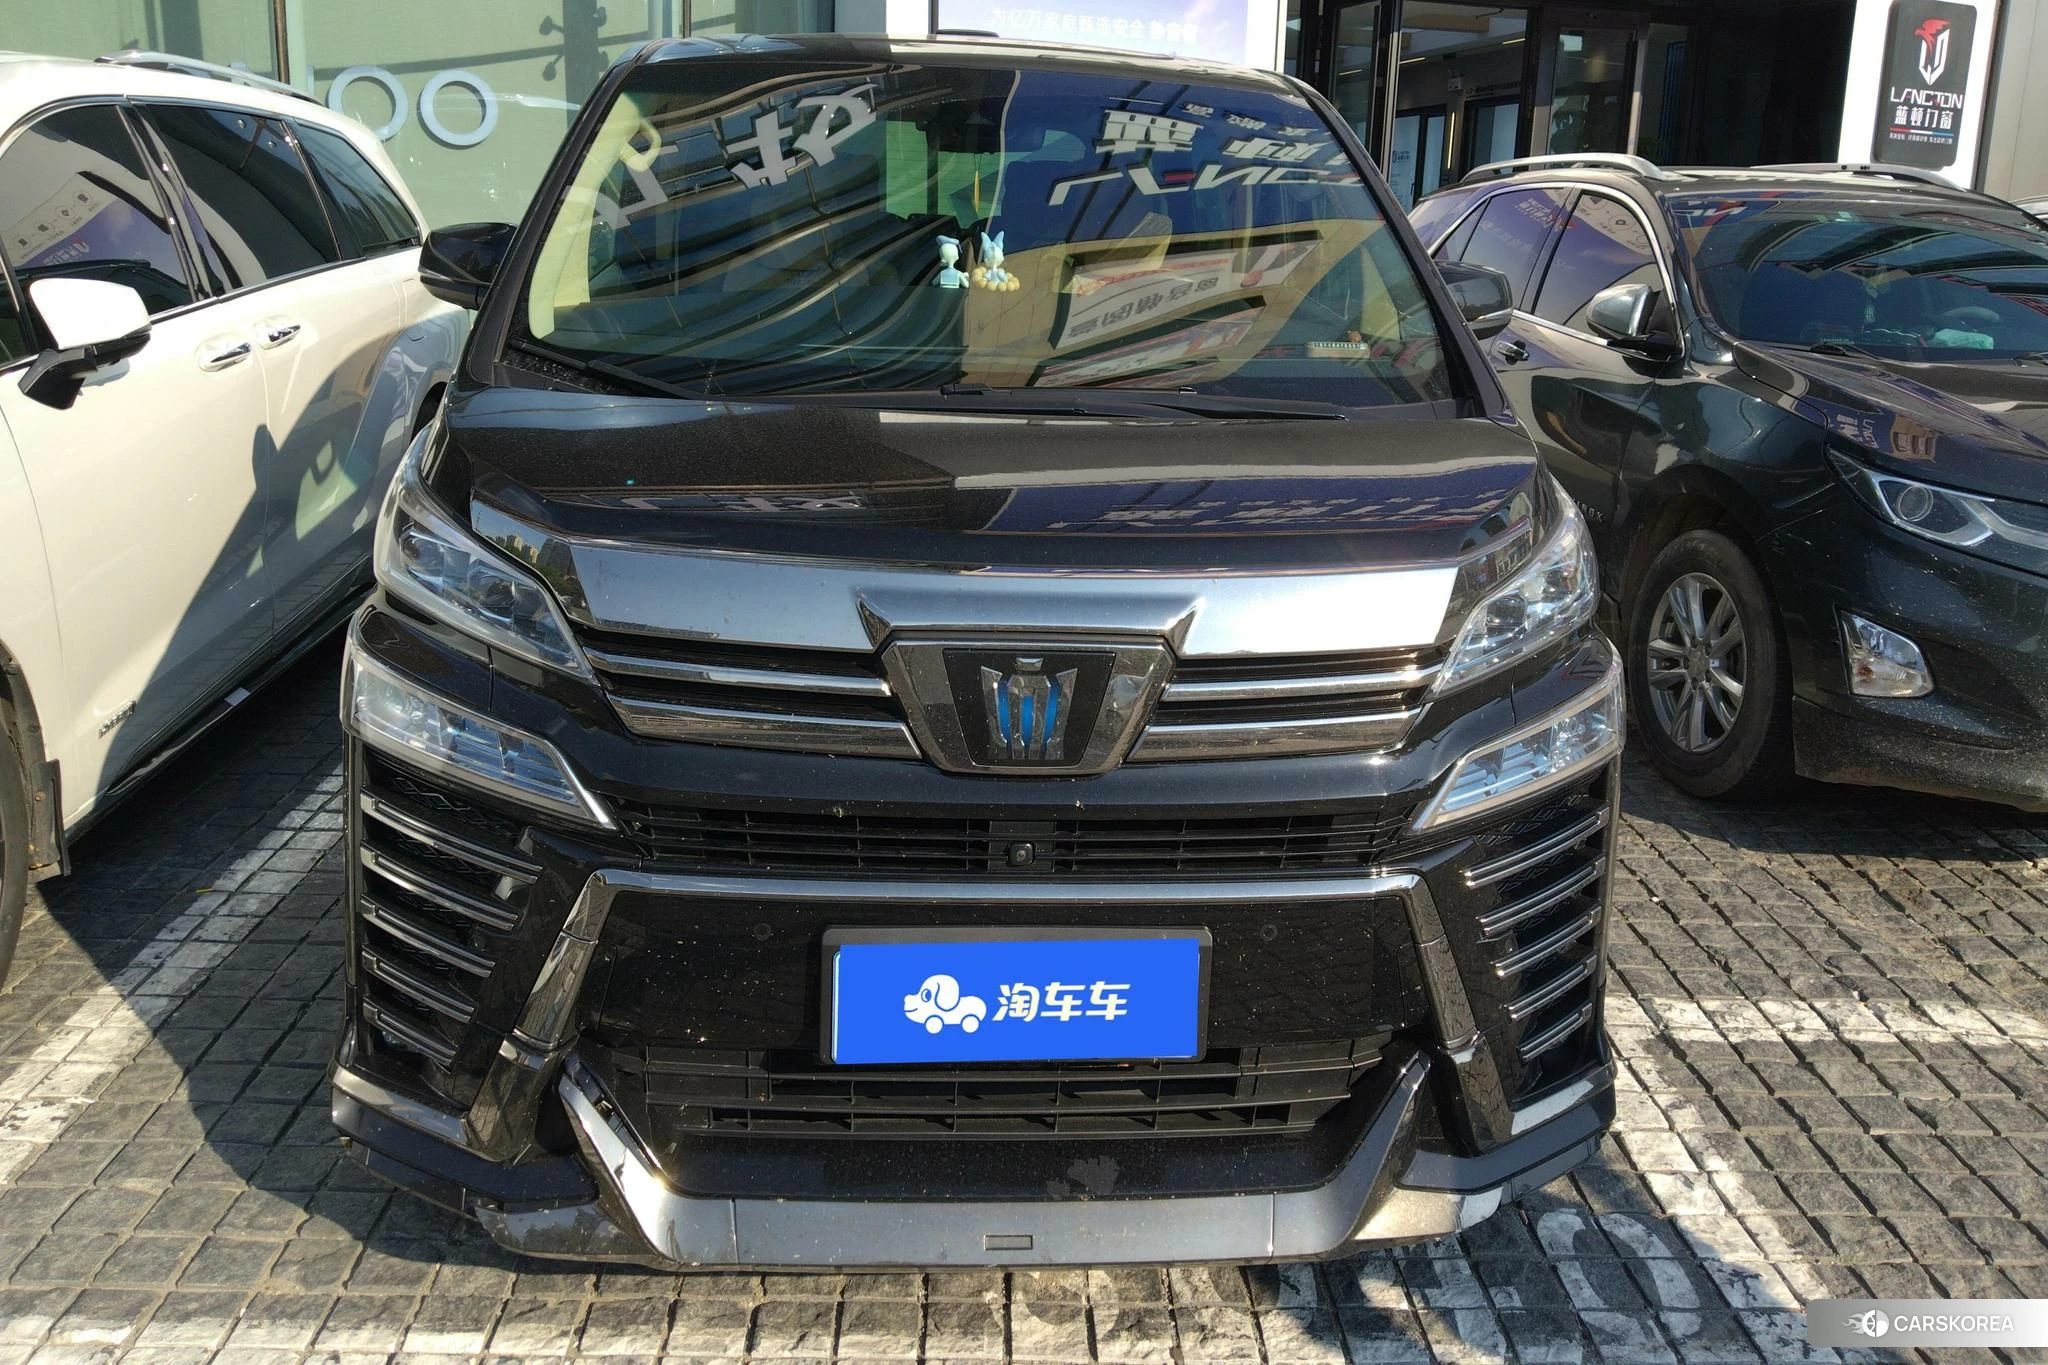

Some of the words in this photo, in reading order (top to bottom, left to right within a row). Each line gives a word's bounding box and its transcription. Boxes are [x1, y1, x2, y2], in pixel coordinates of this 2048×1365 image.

[1890, 86, 1963, 109] LANCTON
[1894, 105, 1954, 129] 蓝顿门窗
[992, 981, 1131, 1022] 淘车车
